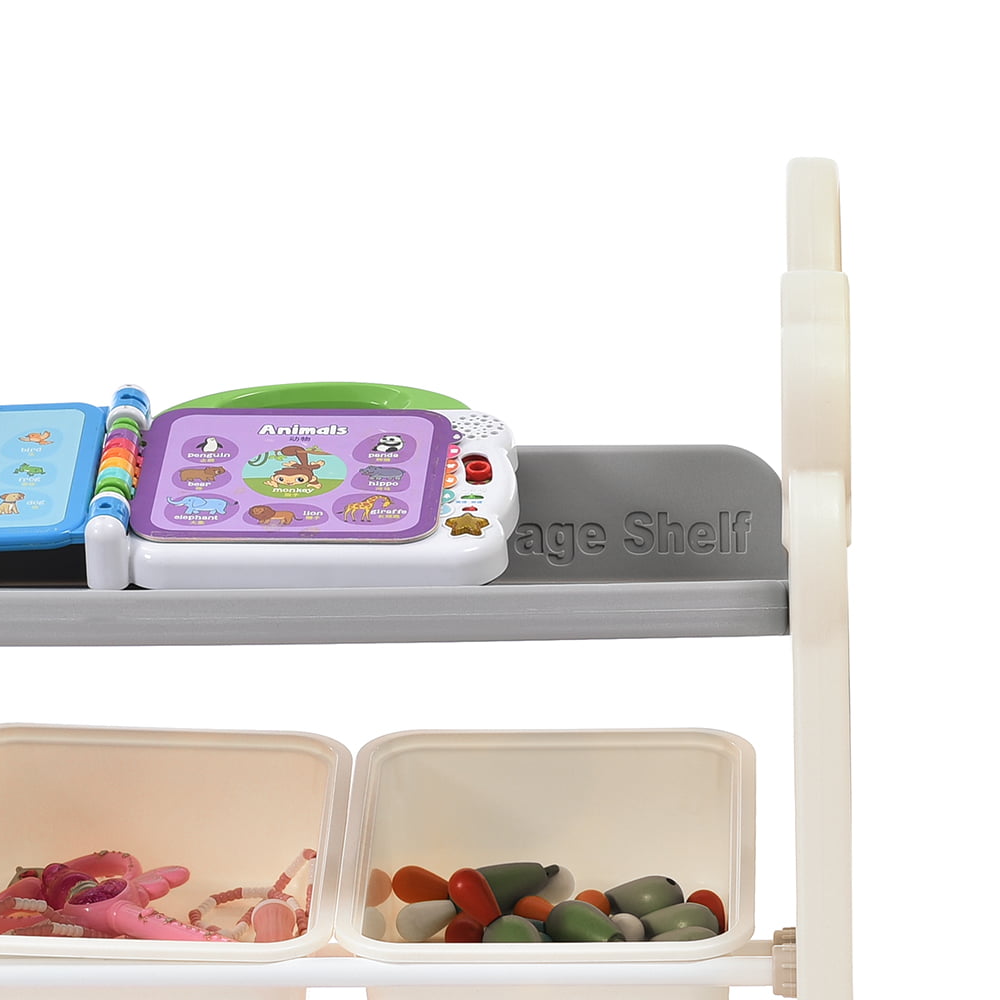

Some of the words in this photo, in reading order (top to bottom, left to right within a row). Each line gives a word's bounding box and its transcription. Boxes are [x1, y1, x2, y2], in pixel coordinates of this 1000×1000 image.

[258, 424, 349, 435] Animals
[370, 508, 408, 516] giraffe
[514, 522, 607, 567] age
[623, 510, 753, 555] Shelf
